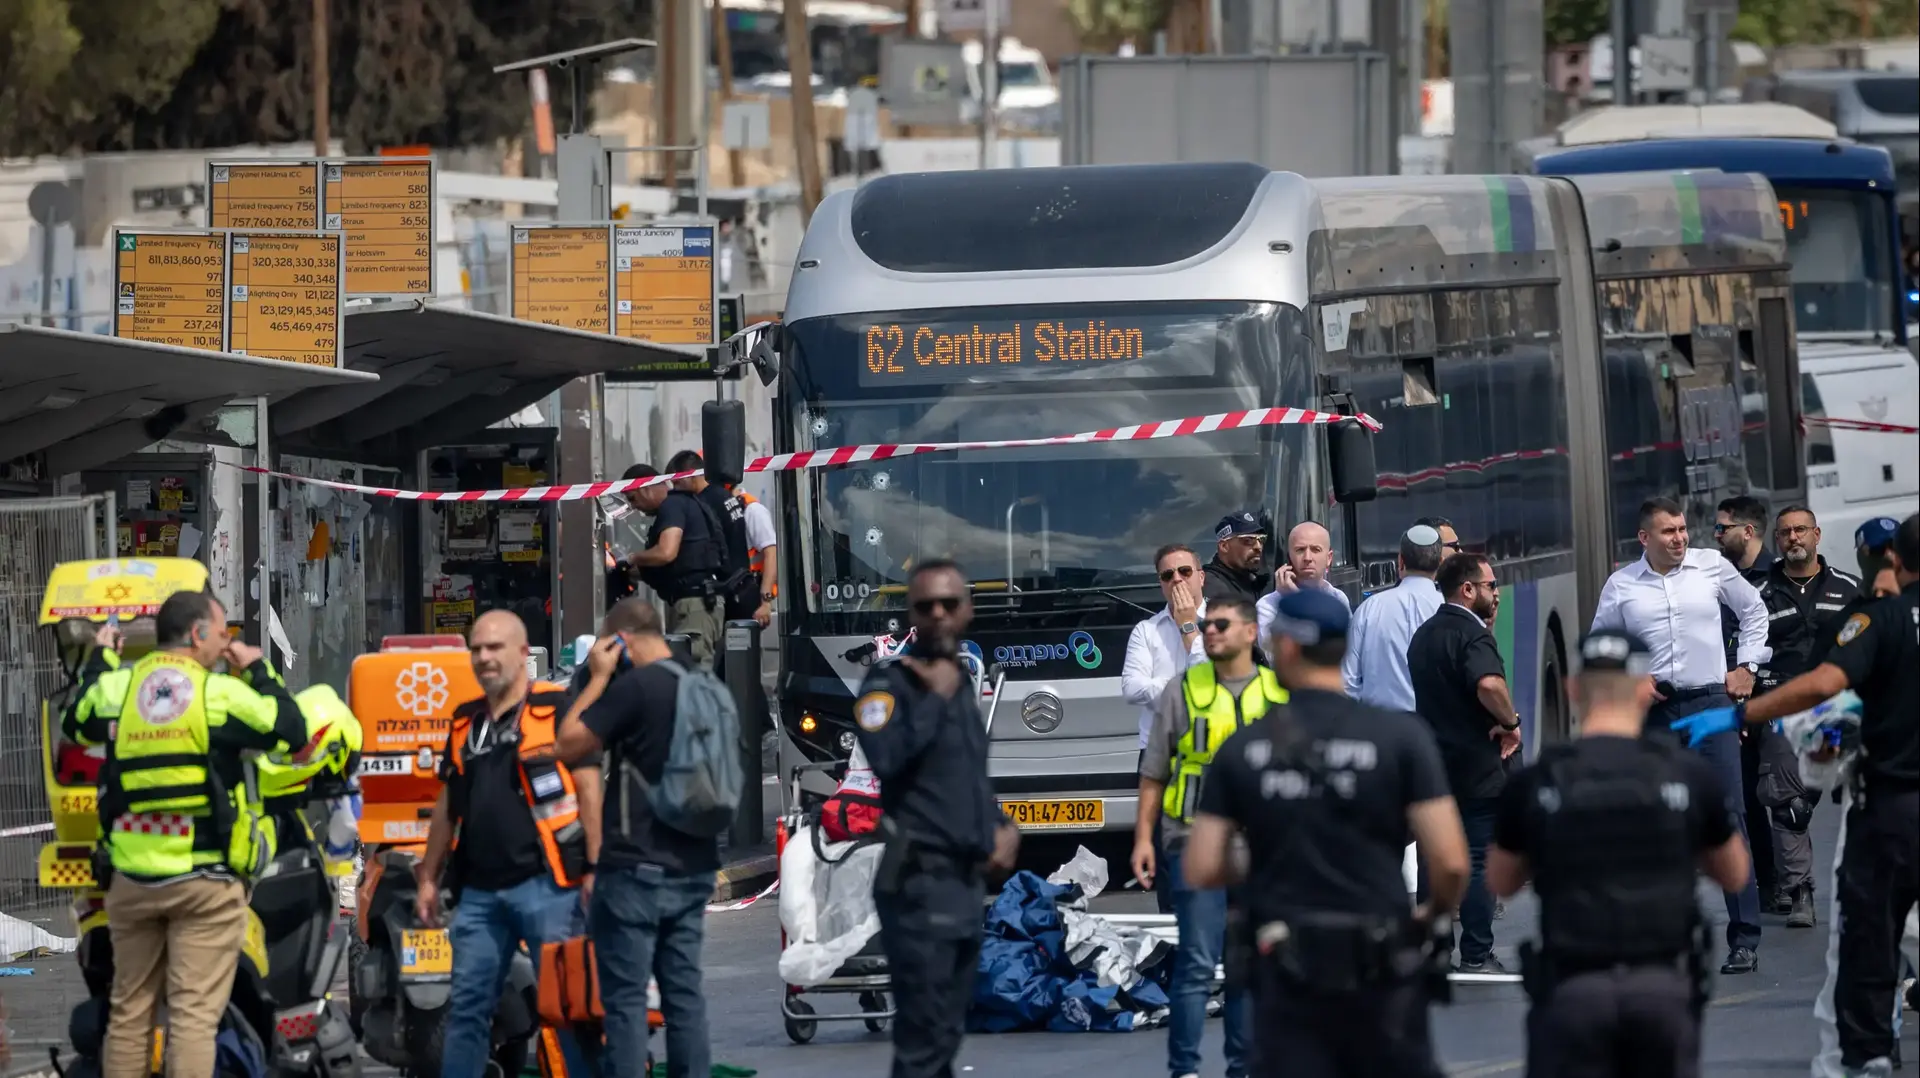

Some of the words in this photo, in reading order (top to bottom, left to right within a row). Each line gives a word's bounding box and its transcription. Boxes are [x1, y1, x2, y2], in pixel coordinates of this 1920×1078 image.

[343, 170, 376, 178] Transport
[298, 185, 316, 195] 541
[408, 184, 427, 194] 580
[257, 203, 294, 211] frequency
[295, 202, 316, 211] 756
[369, 202, 406, 210] frequency
[408, 200, 428, 210] 823
[231, 217, 315, 228] 757,760,762,763
[400, 216, 428, 227] 36,56
[415, 232, 428, 241] 36
[164, 240, 201, 249] frequency
[207, 240, 223, 249] 716
[249, 243, 280, 251] Alighting
[282, 243, 299, 251] Only
[320, 242, 336, 252] 318
[414, 248, 428, 257] 46
[662, 249, 683, 257] 4009
[148, 255, 223, 267] 811,813,860,953
[252, 257, 336, 268] 320,328,330,338
[596, 261, 607, 269] 57
[207, 272, 223, 282] 971
[293, 274, 335, 285] 340,348
[206, 288, 222, 298] 105
[249, 291, 280, 299] Alighting
[281, 291, 298, 299] Only
[305, 290, 335, 301] 121,122
[599, 290, 608, 298] 61
[206, 305, 222, 314] 221
[260, 305, 335, 317] 123,129,145,345
[699, 303, 711, 312] 62
[183, 320, 222, 331] 237,241
[693, 317, 711, 326] 506
[270, 322, 334, 333] 465,469,475
[167, 336, 184, 345] Only
[193, 336, 221, 347] 110,116
[314, 339, 334, 348] 479
[866, 324, 904, 374] 62
[913, 323, 1022, 366] Central
[1033, 320, 1144, 362] Station
[303, 354, 335, 365] 130,131
[994, 643, 1069, 661] סופרבוס
[376, 719, 420, 732] הצלה
[61, 795, 99, 813] 542
